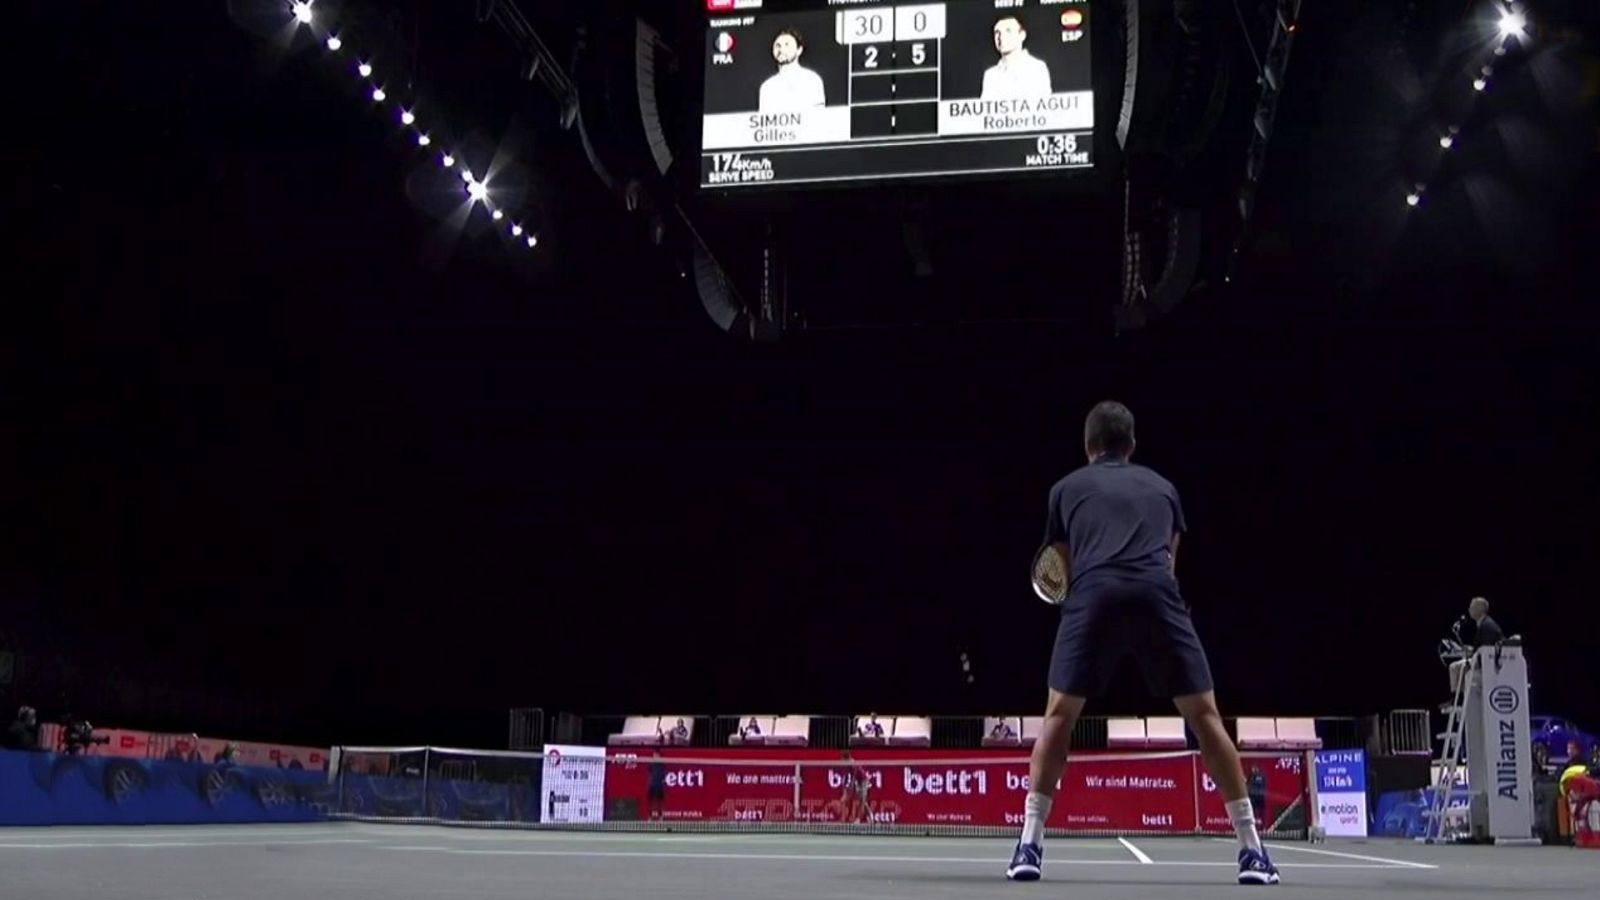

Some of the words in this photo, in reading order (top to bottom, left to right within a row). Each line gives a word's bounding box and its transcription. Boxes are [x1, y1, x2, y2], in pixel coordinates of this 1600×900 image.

[855, 15, 883, 36] 30
[914, 11, 927, 33] 0
[1061, 30, 1083, 42] ESP
[864, 45, 878, 68] 2
[912, 43, 926, 65] 5
[949, 99, 1030, 117] BAUTISTA
[749, 112, 801, 128] SIMON
[984, 114, 1047, 129] Roberto
[754, 128, 797, 142] Gilles
[1036, 134, 1077, 154] 0:36
[1025, 153, 1063, 166] MATCH
[1063, 151, 1089, 163] TIME
[708, 172, 741, 183] SERVE
[741, 169, 774, 181] SPEED
[1314, 753, 1361, 764] ALPINE
[1496, 719, 1519, 801] Allianz
[665, 769, 704, 787] ett1
[727, 773, 741, 784] We
[742, 775, 759, 784] are
[904, 766, 987, 795] bett1
[1086, 776, 1103, 787] Wir
[1105, 776, 1127, 787] sind
[1142, 814, 1173, 826] bett1
